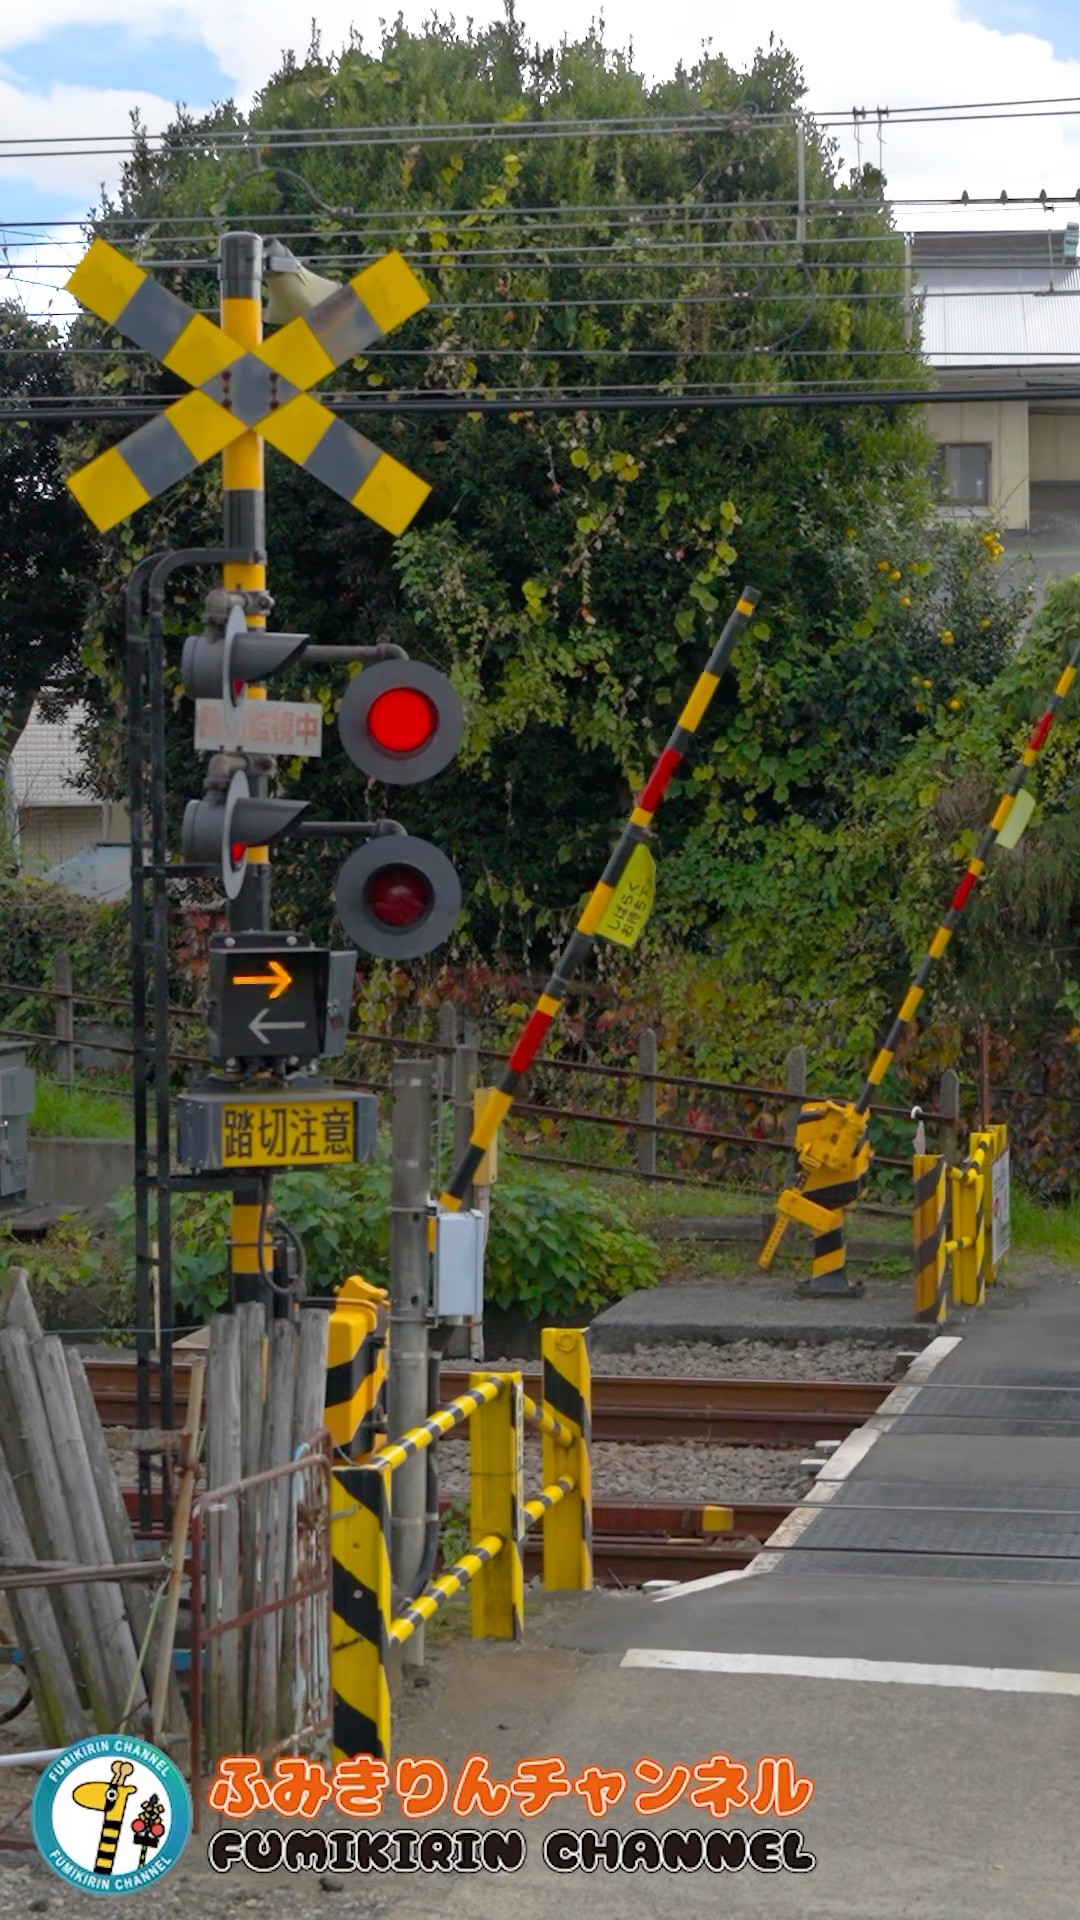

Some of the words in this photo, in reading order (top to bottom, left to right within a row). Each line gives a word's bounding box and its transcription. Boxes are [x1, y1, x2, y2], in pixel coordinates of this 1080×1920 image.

[607, 881, 641, 931] しばらく
[224, 1106, 351, 1158] 踏切注意
